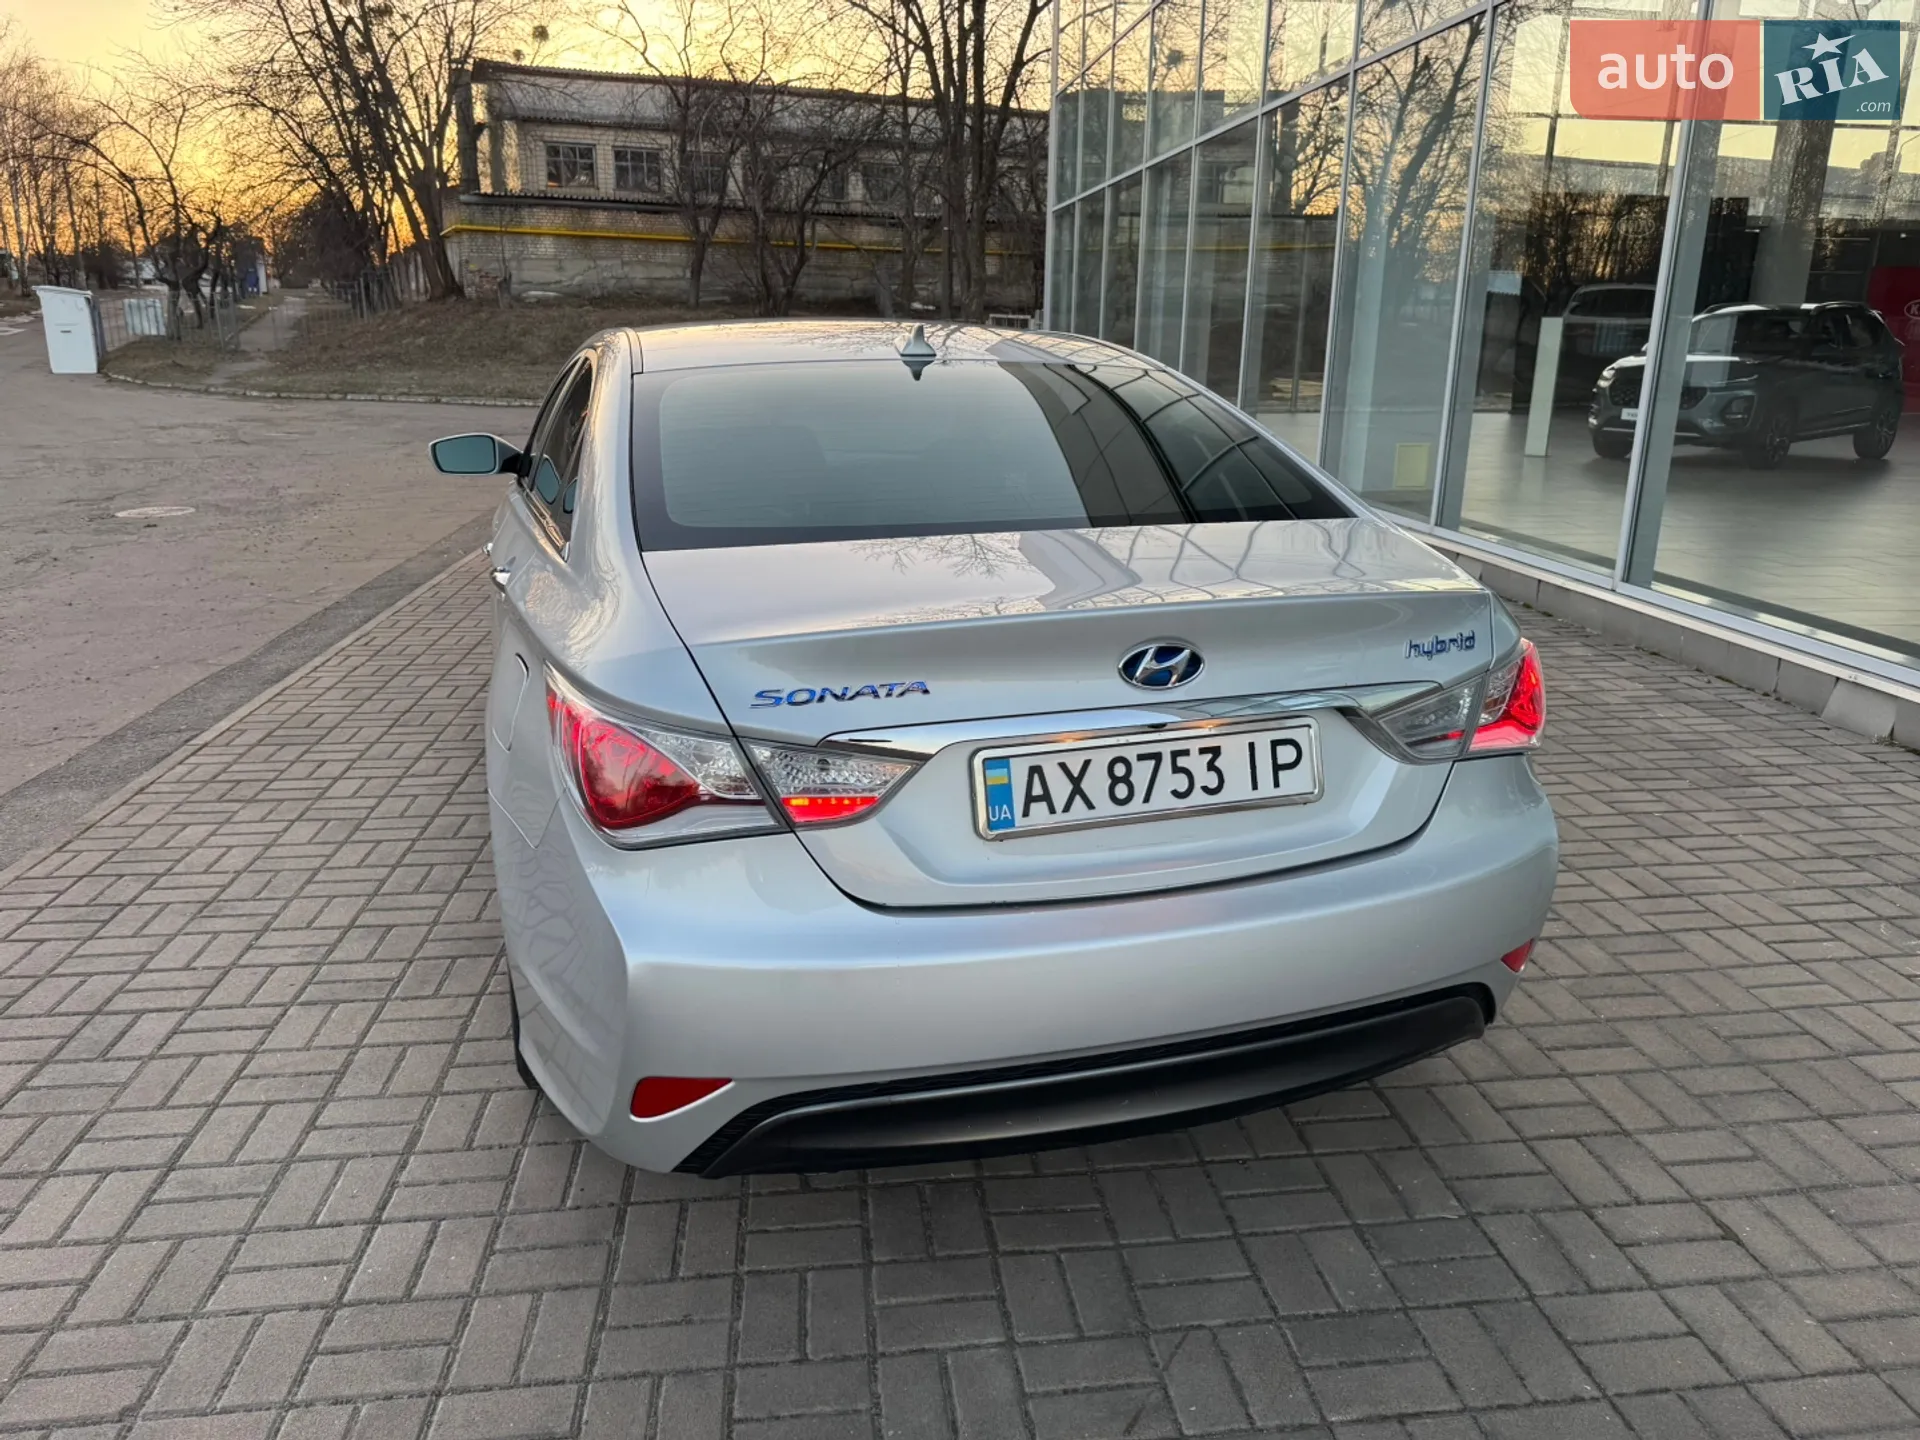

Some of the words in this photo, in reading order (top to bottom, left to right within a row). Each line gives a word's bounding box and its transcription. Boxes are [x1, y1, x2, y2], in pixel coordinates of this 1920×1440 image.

[1405, 629, 1476, 661] hybrid
[749, 681, 930, 709] SONATA
[1021, 759, 1096, 818] AX
[1107, 745, 1225, 807] 8753
[1248, 738, 1304, 791] IP
[989, 804, 1012, 821] UA
